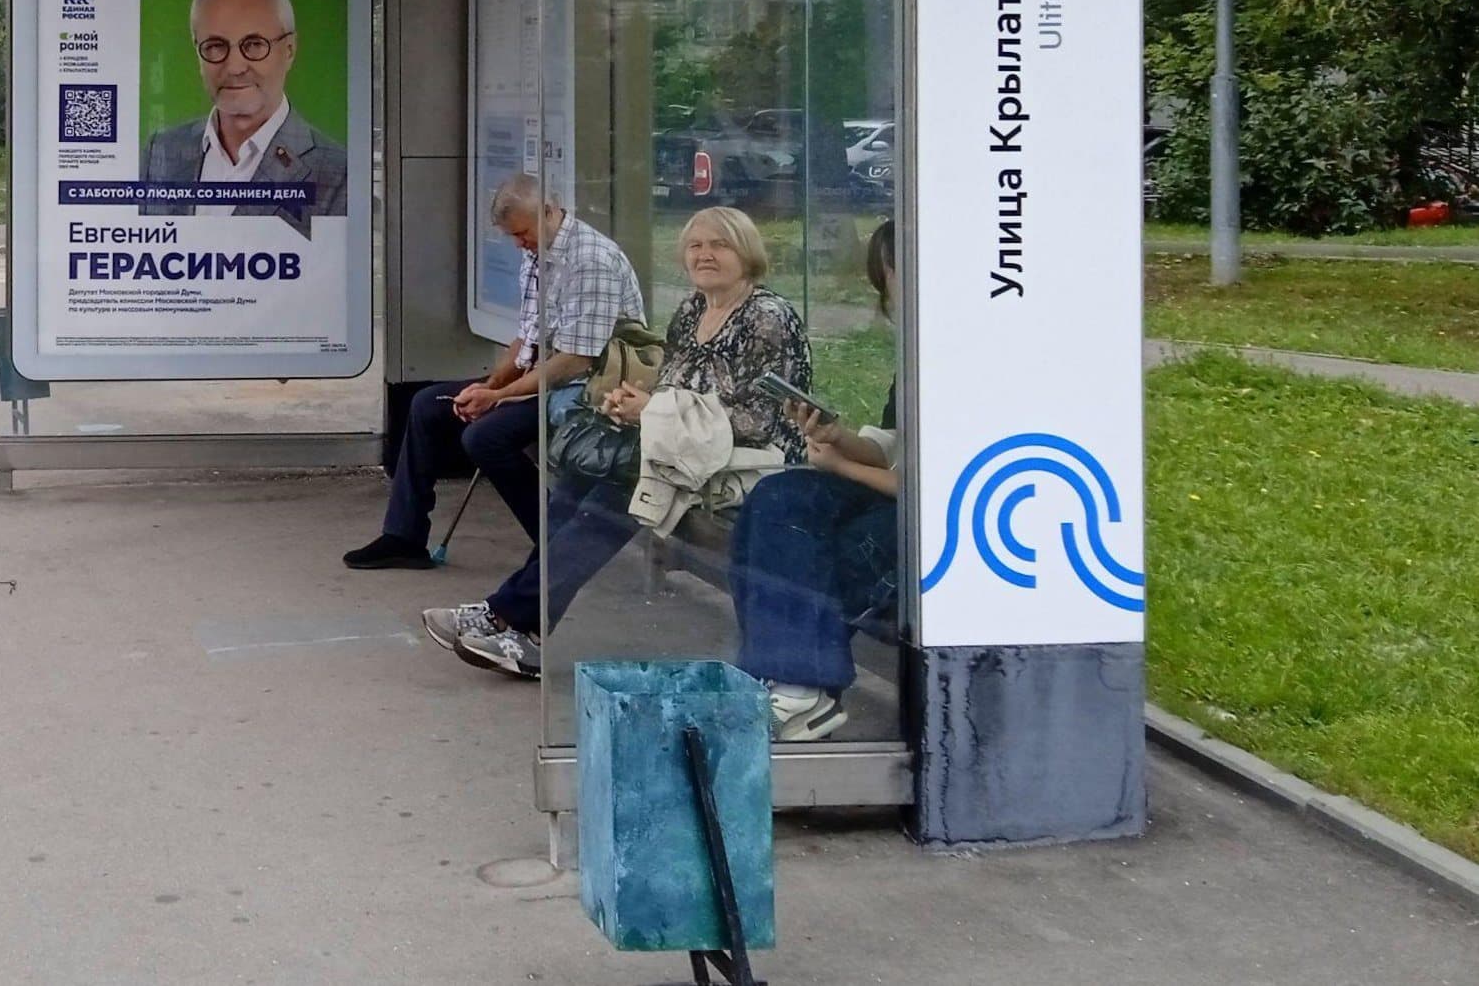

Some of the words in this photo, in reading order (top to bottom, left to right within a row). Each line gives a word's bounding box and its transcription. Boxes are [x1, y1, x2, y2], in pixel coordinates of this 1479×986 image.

[69, 189, 77, 197] С
[79, 186, 133, 197] ЗАБОТОЙ
[136, 189, 145, 198] О
[147, 189, 195, 199] ЛЮДЯХ.
[197, 189, 213, 198] СО
[215, 189, 271, 198] ЗНАНИЕМ
[273, 189, 306, 199] ДЕЛА
[69, 222, 177, 243] Евгений
[989, 168, 1028, 299] Улица
[69, 252, 301, 280] ГЕРАСИМОВ
